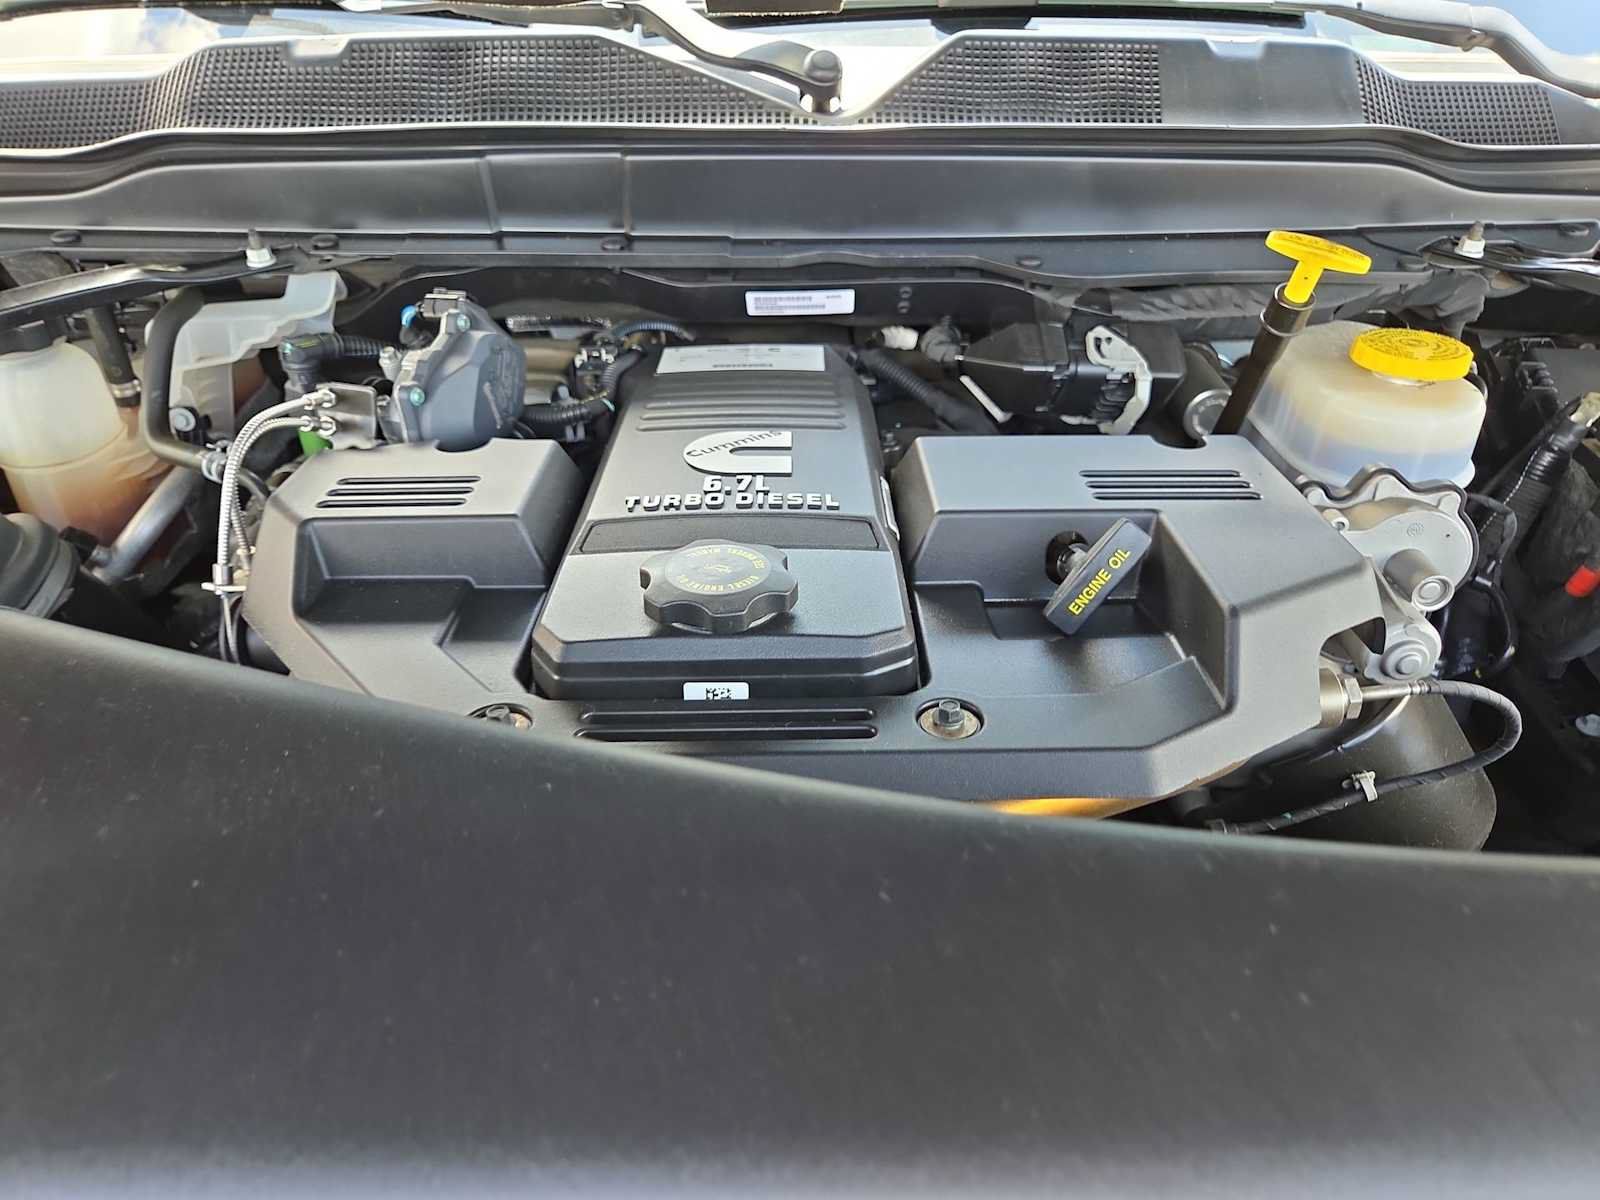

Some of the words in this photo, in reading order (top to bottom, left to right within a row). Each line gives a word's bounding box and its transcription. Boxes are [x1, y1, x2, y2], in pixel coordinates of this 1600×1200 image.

[685, 430, 783, 458] Cummins
[703, 475, 770, 495] 6.7L
[625, 493, 725, 511] TURBO
[735, 493, 840, 510] DIESEL
[1068, 568, 1112, 615] ENGINE
[1108, 549, 1131, 569] OIL
